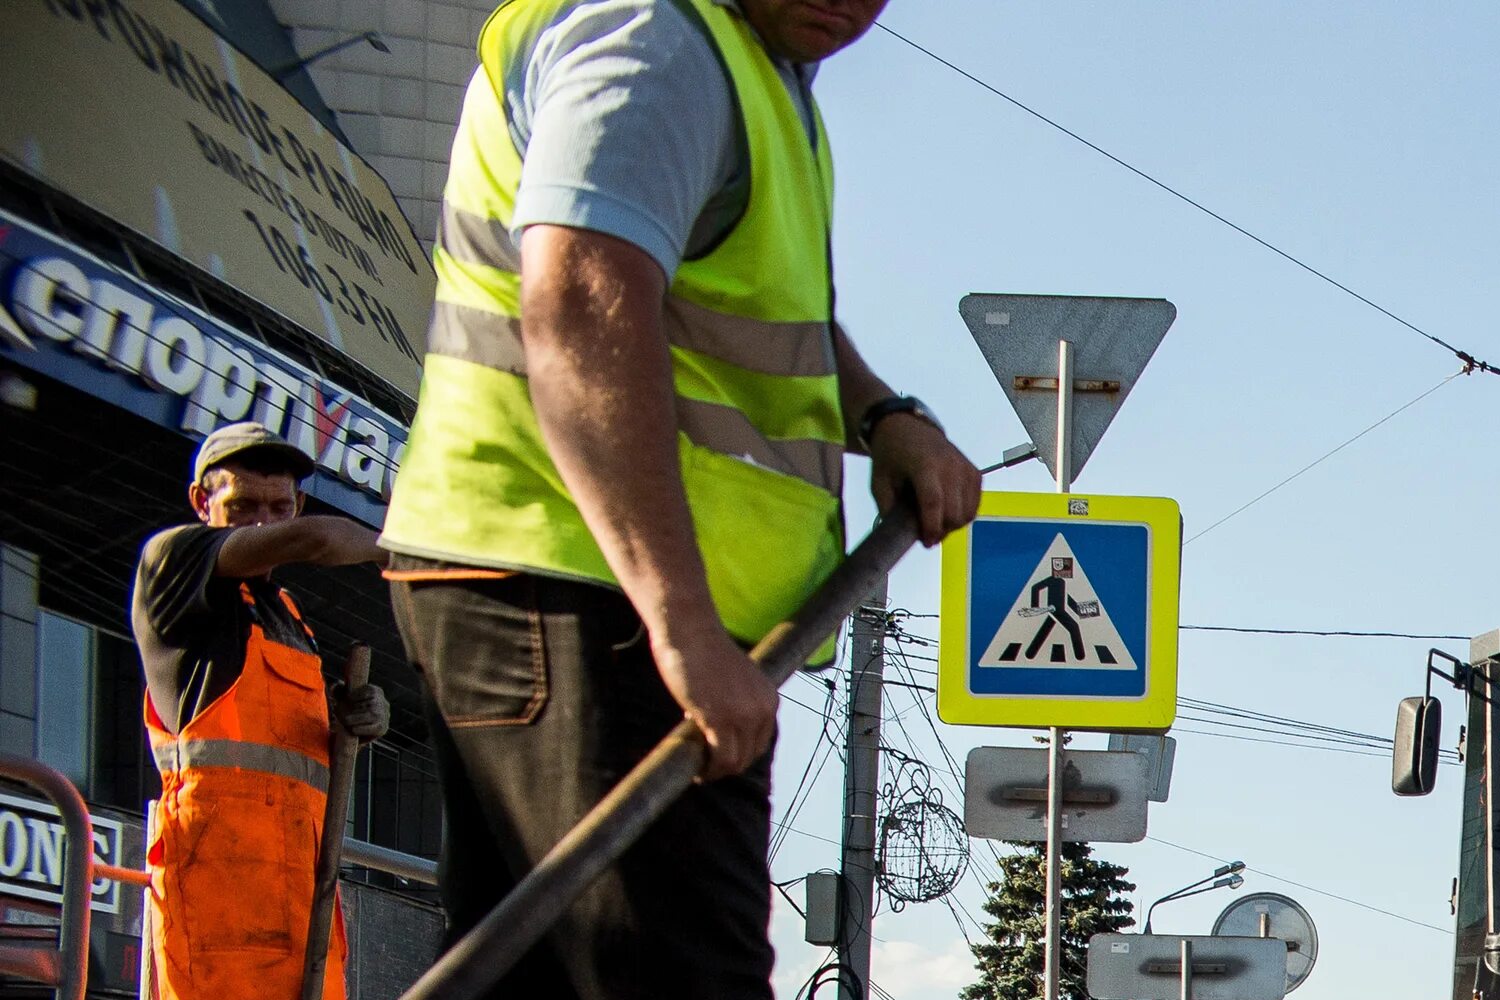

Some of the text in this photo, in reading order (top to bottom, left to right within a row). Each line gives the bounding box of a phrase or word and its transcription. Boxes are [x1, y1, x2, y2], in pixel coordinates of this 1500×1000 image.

[280, 124, 418, 276] РАДИО
[242, 208, 423, 367] 106.3 FM
